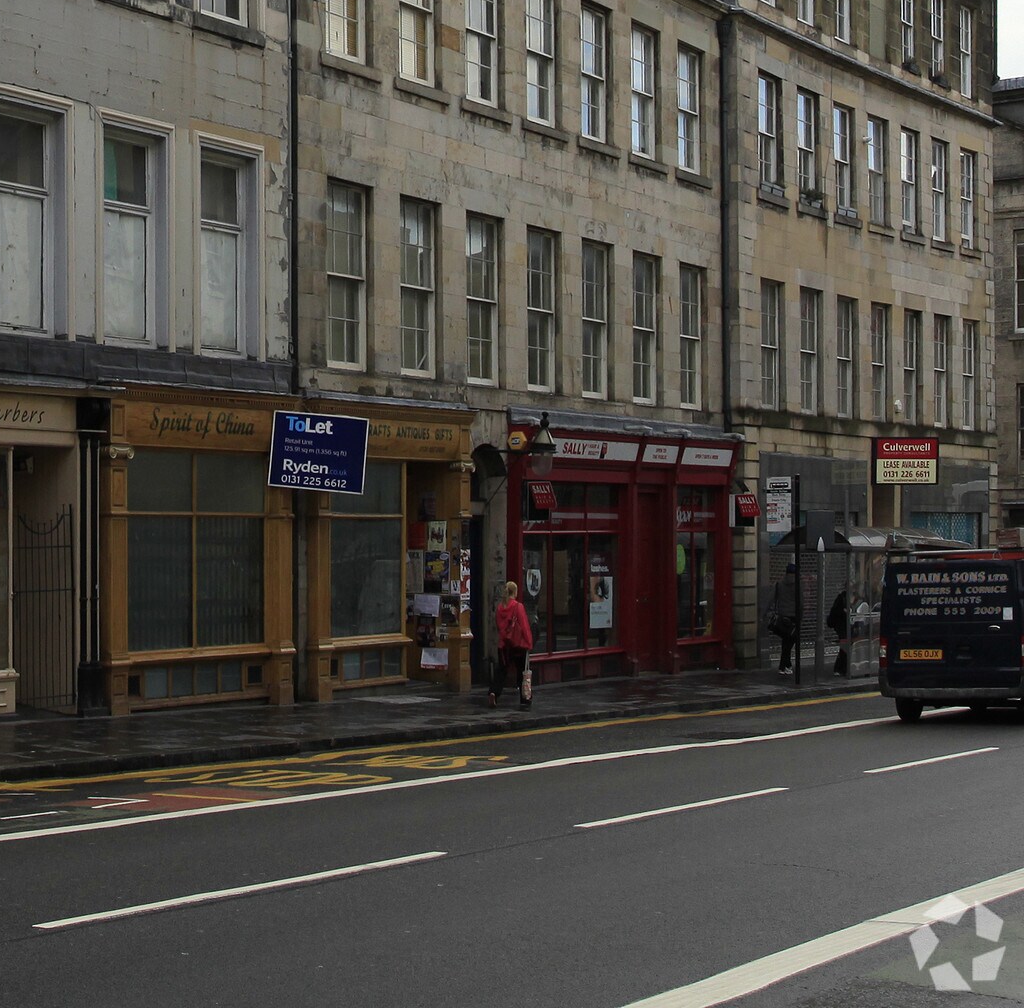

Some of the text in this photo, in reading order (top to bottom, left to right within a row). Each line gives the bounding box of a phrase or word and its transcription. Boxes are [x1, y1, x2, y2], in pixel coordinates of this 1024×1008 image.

[149, 407, 255, 439] Spirit of China
[368, 424, 453, 441] RAFTS ANTIQUES GIFTS
[562, 441, 588, 455] SALLY
[882, 442, 931, 452] Culverwell
[883, 460, 930, 469] LEASE AVAILABLE
[883, 470, 898, 478] 0131
[900, 470, 913, 478] 226
[281, 474, 347, 488] 0131 225 6612
[531, 485, 550, 494] SALLY
[737, 496, 755, 504] SALLY
[911, 572, 941, 584] BAIN
[941, 572, 951, 583] &
[951, 571, 986, 583] SONS
[897, 586, 951, 596] PLASTERERS
[965, 585, 1008, 594] CORNICE
[920, 596, 982, 605] SPECIALISTS
[903, 607, 938, 616] PHONE
[973, 606, 1001, 615] 2009
[903, 650, 923, 658] SL56
